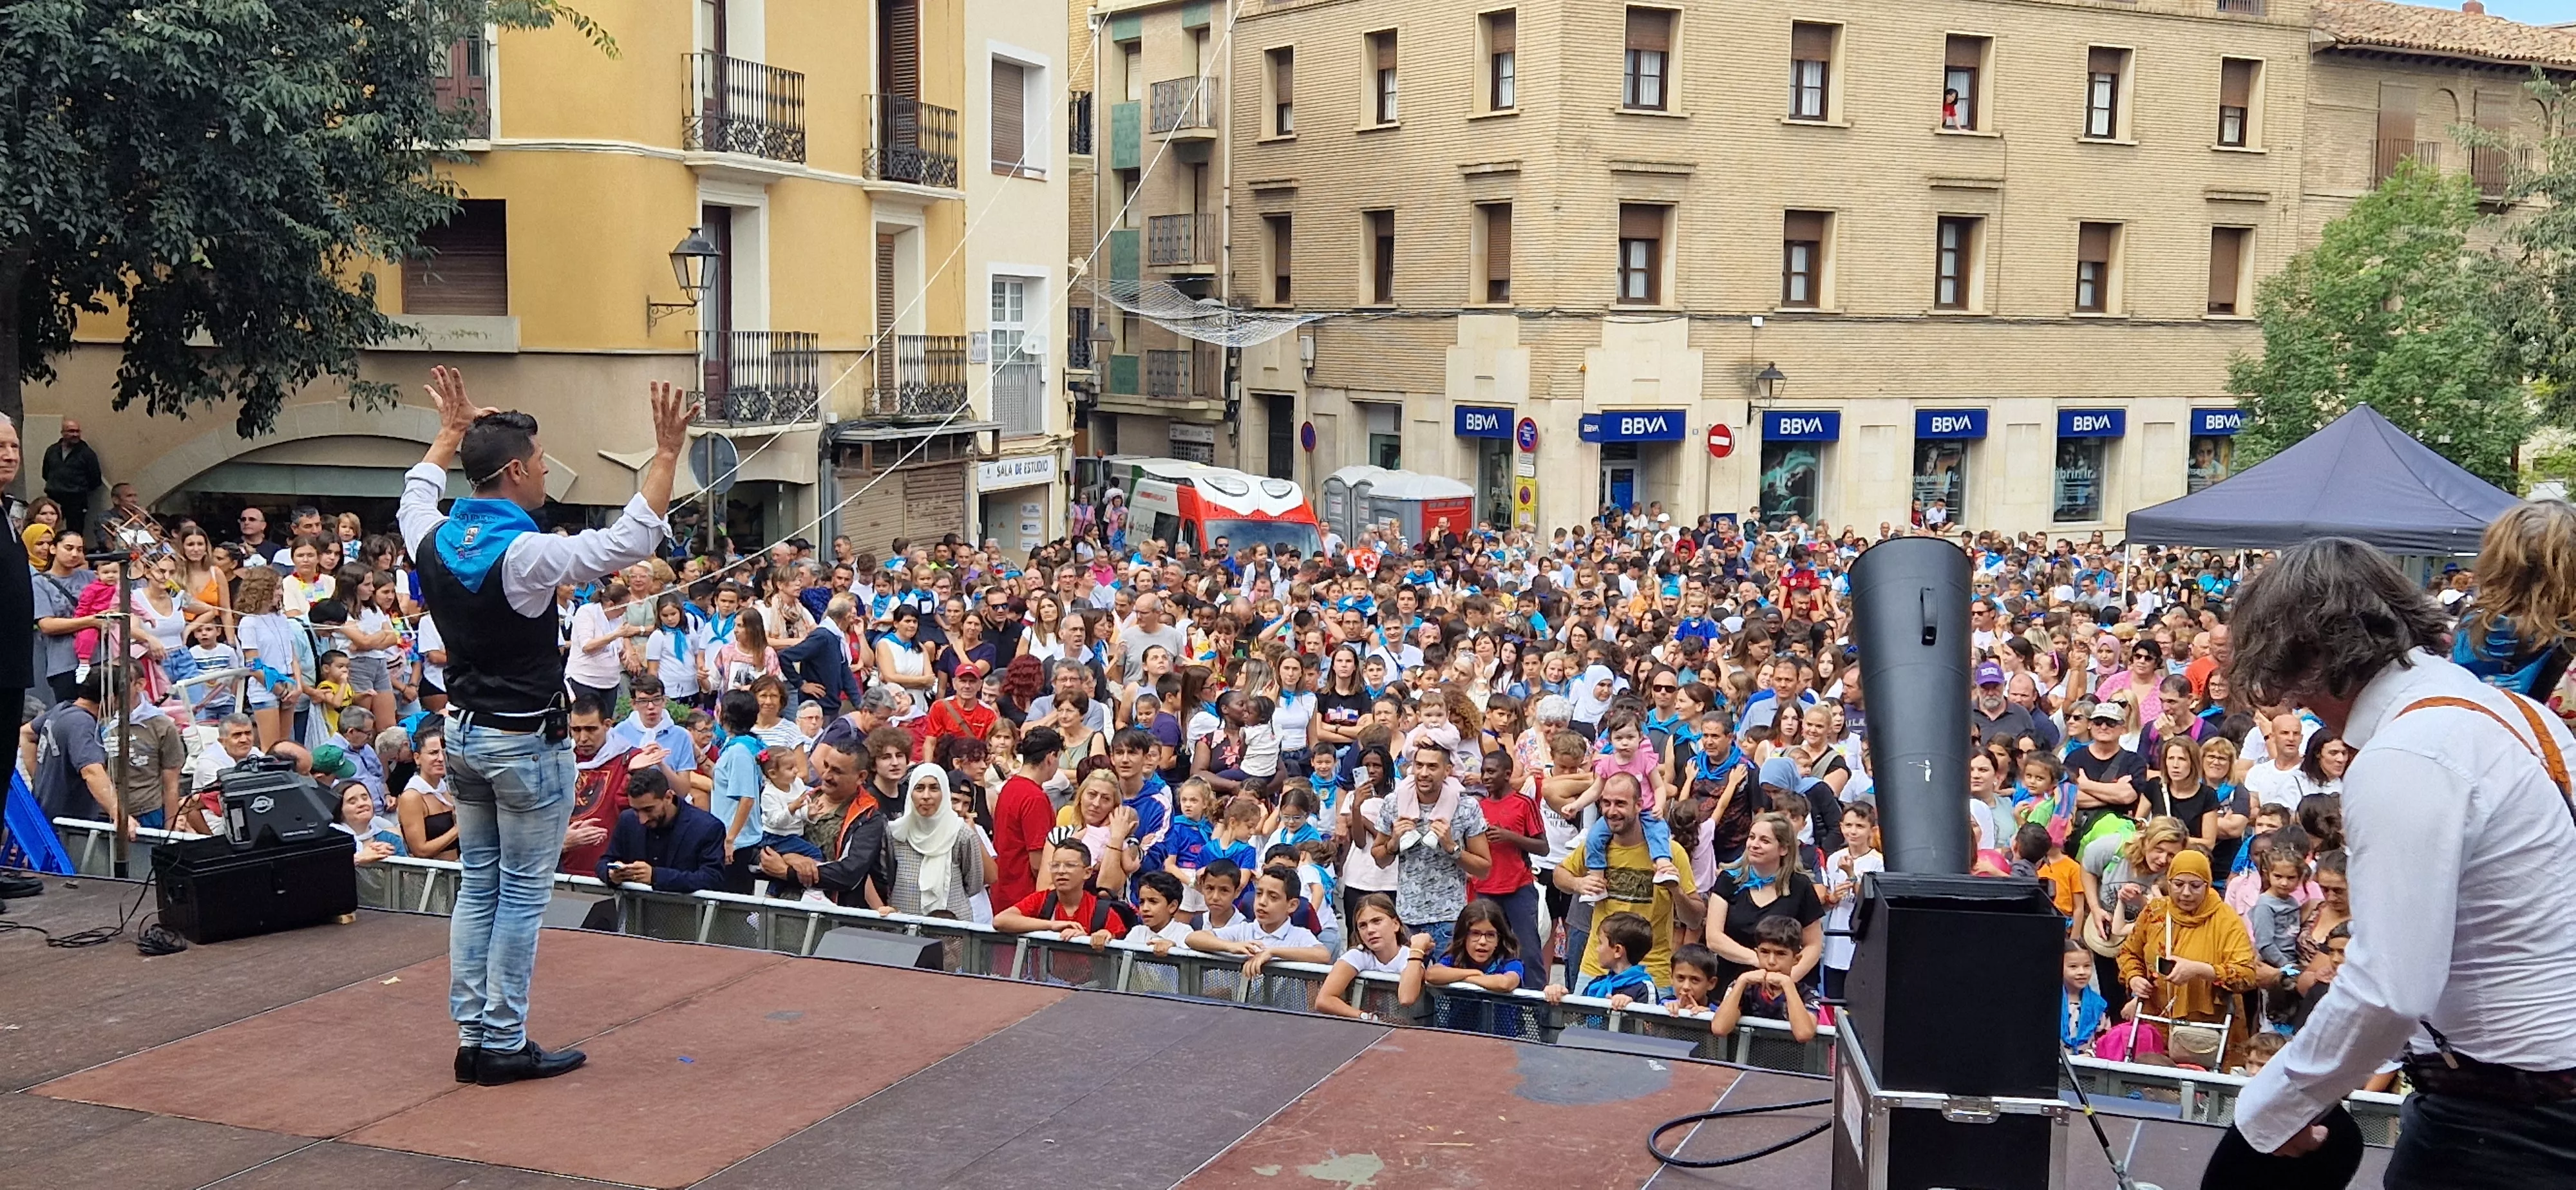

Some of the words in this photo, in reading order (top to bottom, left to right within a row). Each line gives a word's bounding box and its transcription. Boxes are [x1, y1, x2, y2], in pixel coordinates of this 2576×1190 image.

[1466, 413, 1499, 430] BBVA
[1621, 415, 1667, 435] BBVA
[1780, 417, 1823, 435] BBVA
[1931, 415, 1972, 432] BBVA
[2073, 414, 2111, 431] BBVA
[2206, 413, 2240, 430] BBVA
[997, 464, 1012, 478] SALA
[1015, 464, 1022, 475] DE
[1023, 459, 1048, 475] ESTUDIO
